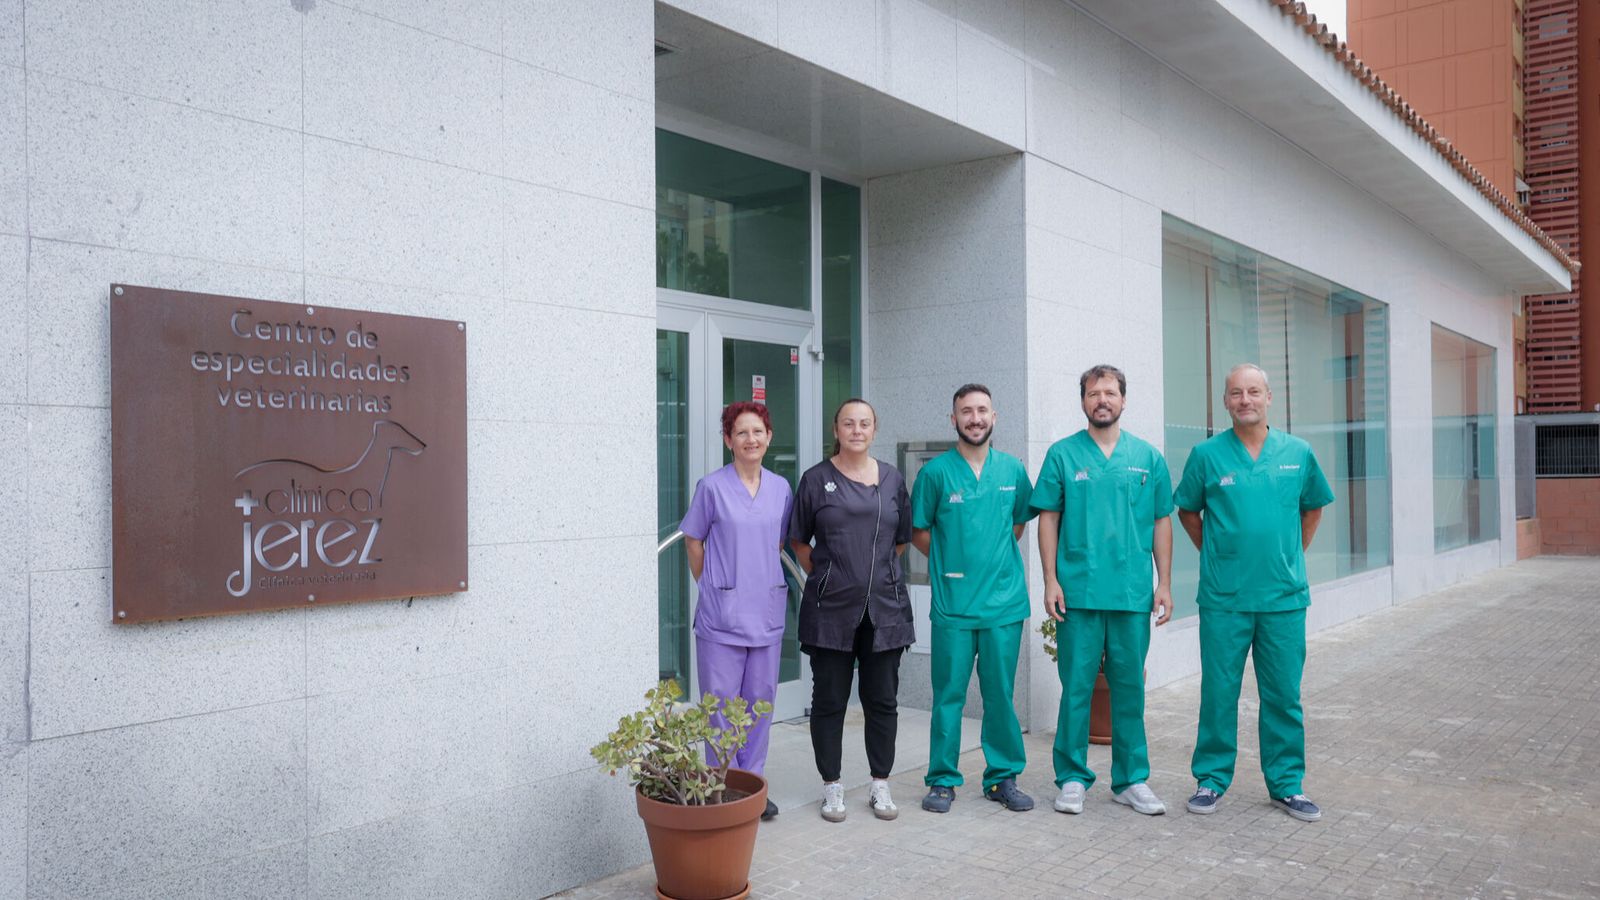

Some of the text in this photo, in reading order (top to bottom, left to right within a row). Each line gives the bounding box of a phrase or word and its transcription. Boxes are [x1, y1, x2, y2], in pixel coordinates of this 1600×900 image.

[230, 309, 379, 349] Centro de
[190, 350, 411, 383] especialidades
[217, 386, 392, 413] veterinarias
[225, 518, 383, 597] jerez
